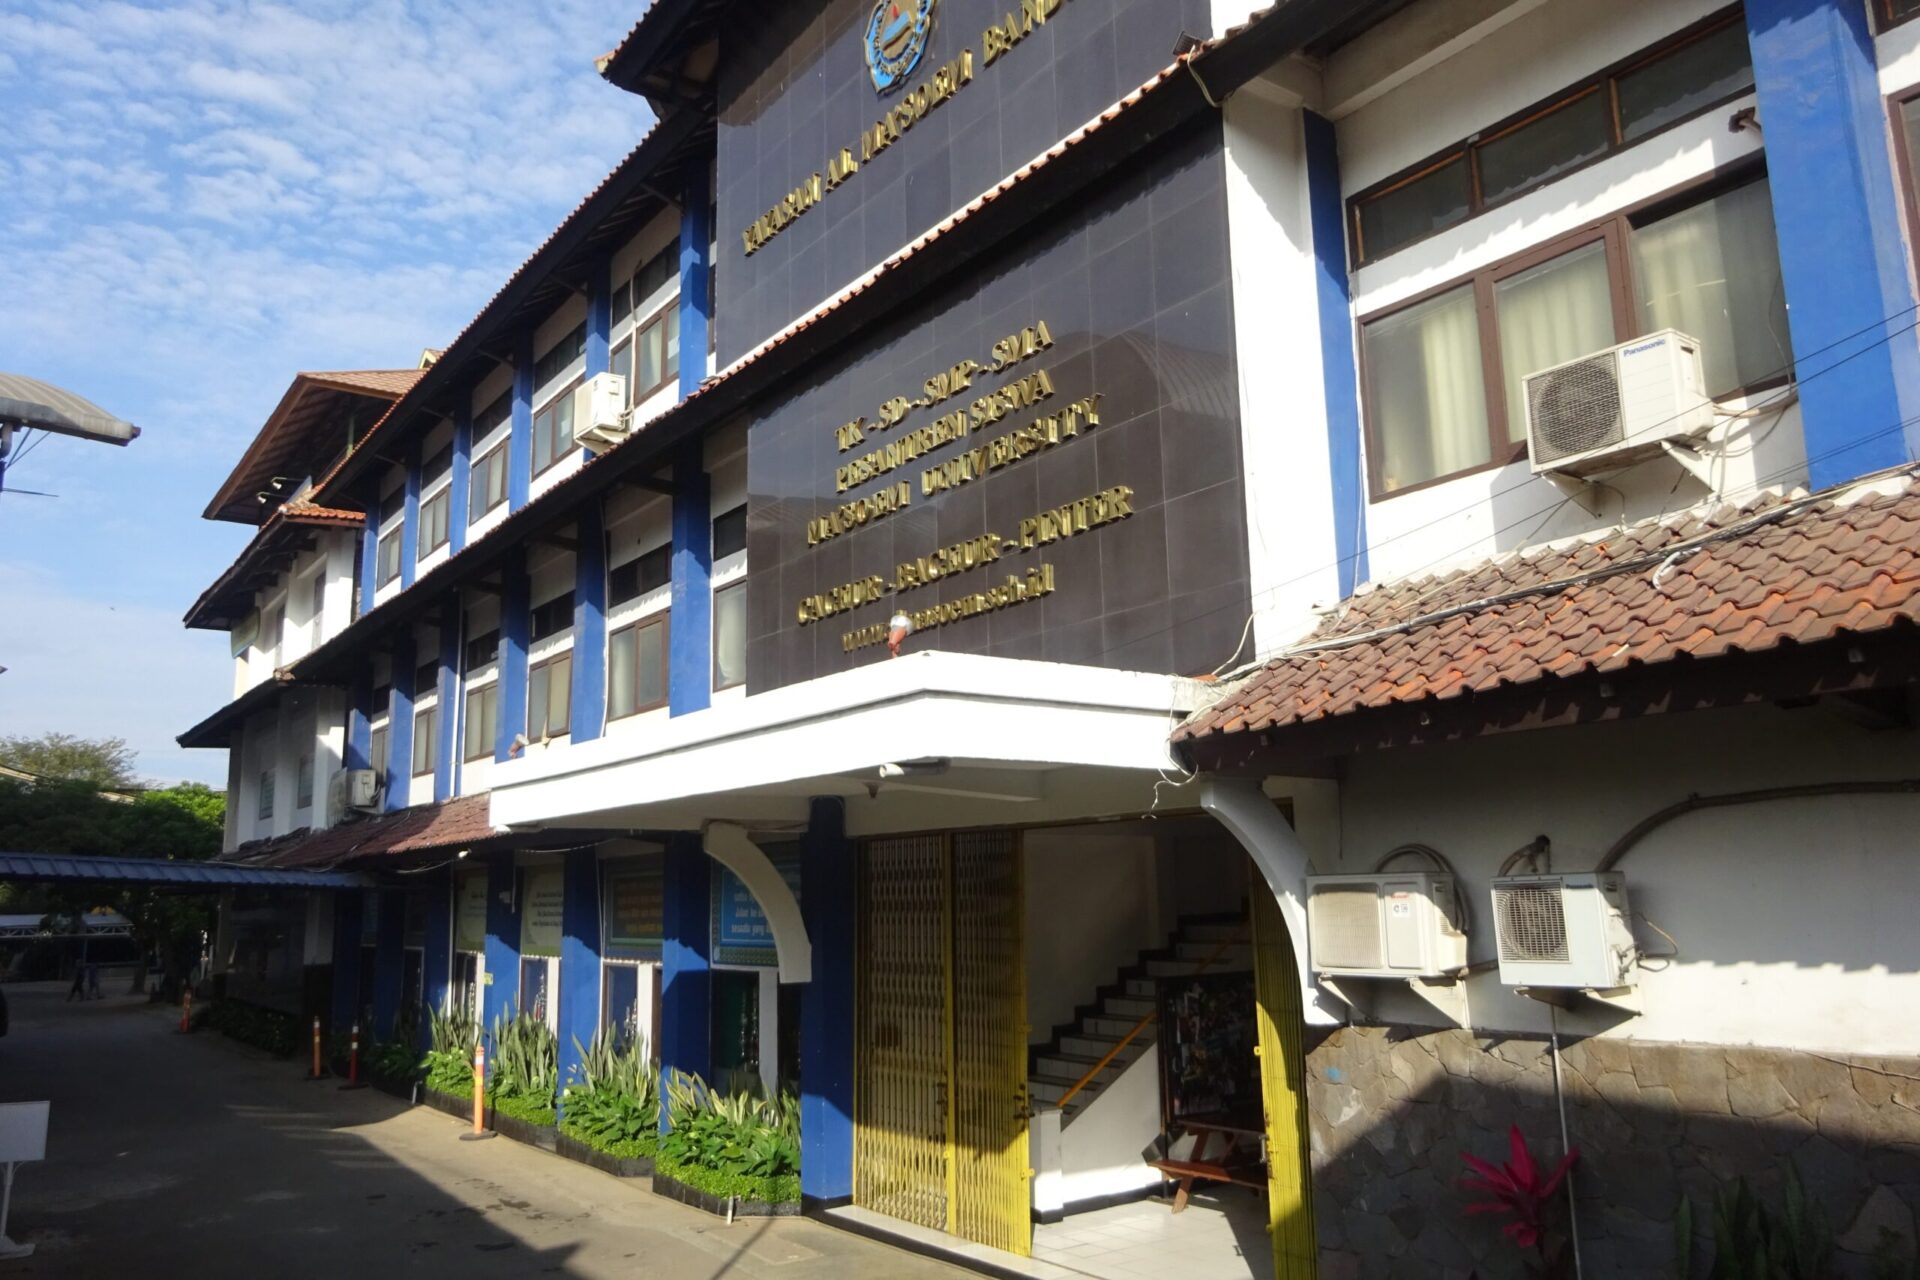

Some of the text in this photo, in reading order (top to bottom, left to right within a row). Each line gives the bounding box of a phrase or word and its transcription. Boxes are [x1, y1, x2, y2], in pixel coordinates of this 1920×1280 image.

[742, 173, 822, 256] YAYASAN
[825, 148, 858, 192] AL
[1623, 339, 1666, 357] Panasonic
[835, 369, 1055, 493] PESANTREN SISWA
[836, 416, 867, 453] TK
[921, 392, 1105, 496] UNIVERSITY
[1019, 485, 1135, 551] PINTER
